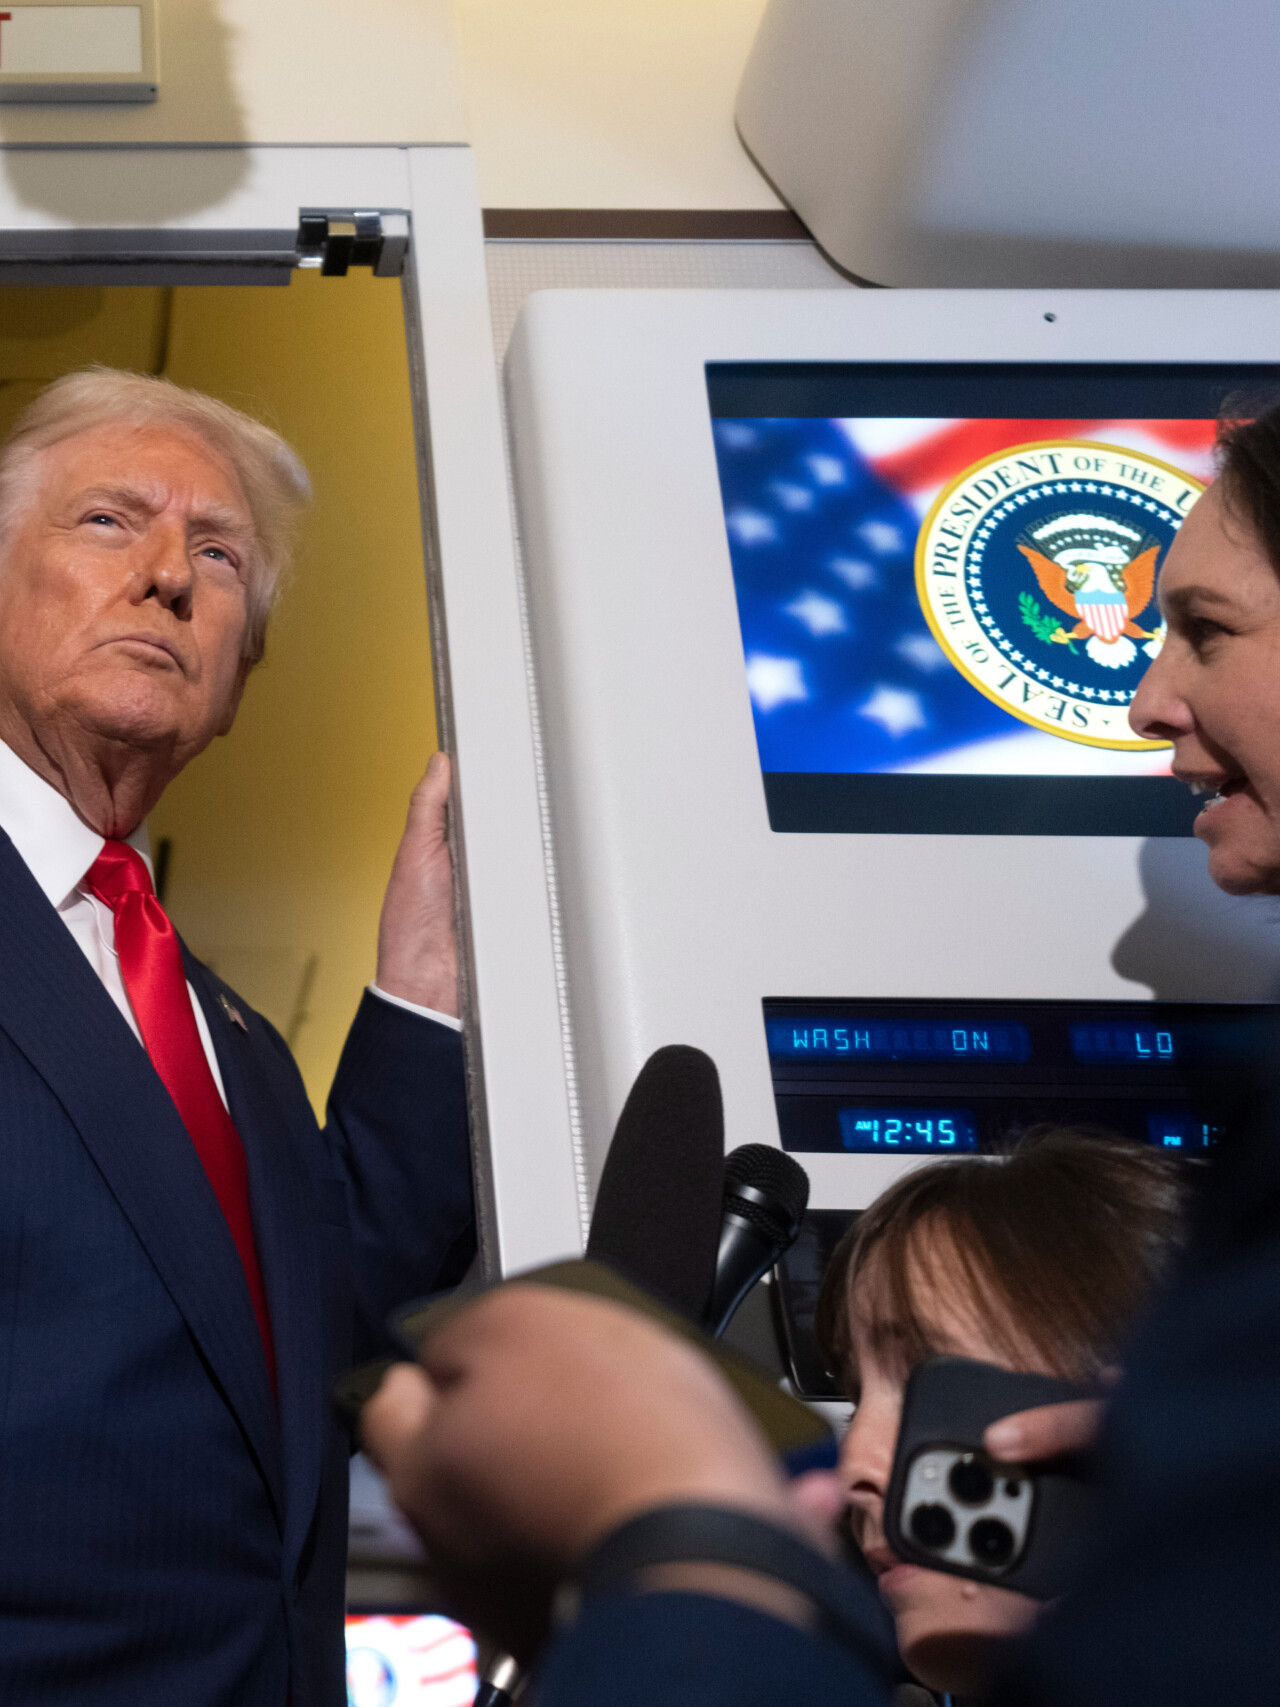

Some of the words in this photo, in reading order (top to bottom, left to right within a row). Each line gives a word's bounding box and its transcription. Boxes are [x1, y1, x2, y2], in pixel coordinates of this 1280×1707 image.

[1073, 455, 1107, 473] OF
[1116, 462, 1166, 492] THE
[932, 453, 1065, 579] PRESIDENT
[937, 586, 966, 630] THE
[960, 638, 990, 664] OF
[997, 663, 1091, 728] SEAL
[792, 1028, 871, 1050] WASH
[952, 1029, 989, 1051] ON
[872, 1119, 956, 1144] 12:45
[1163, 1135, 1182, 1146] PM
